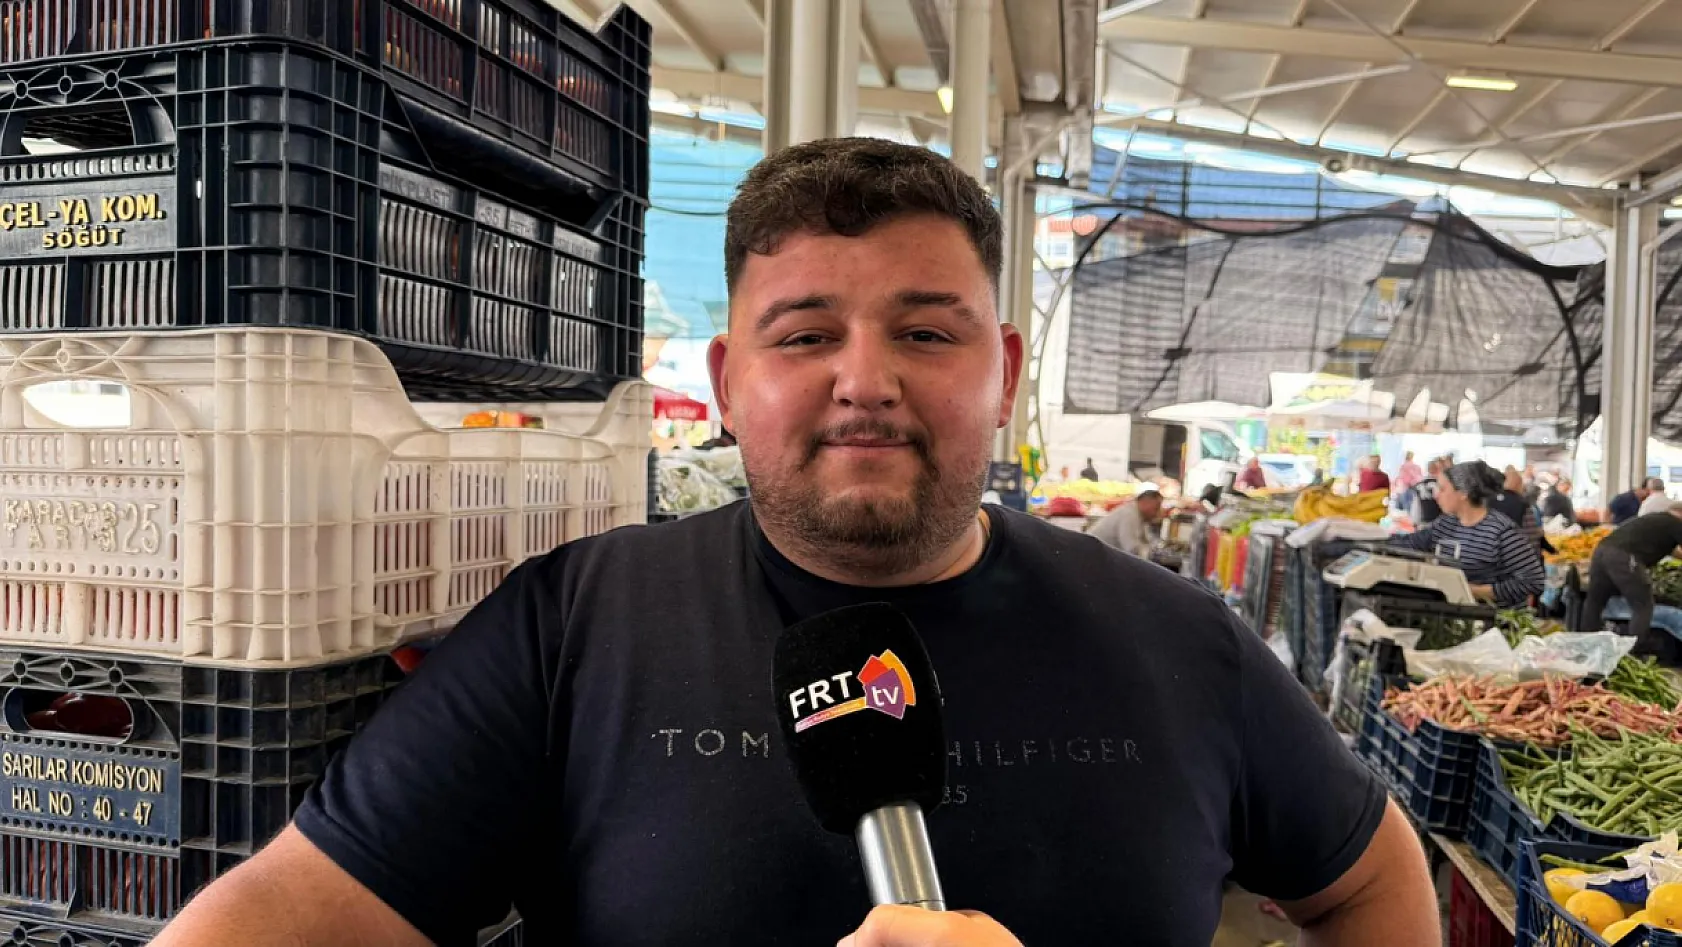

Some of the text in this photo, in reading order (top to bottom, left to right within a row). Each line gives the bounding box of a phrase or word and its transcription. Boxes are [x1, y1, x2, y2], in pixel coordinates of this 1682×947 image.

[102, 194, 164, 221] KOM.
[43, 226, 123, 248] SÖĞÜT
[123, 503, 161, 555] 25
[789, 670, 853, 719] FRT
[871, 686, 899, 707] tv
[659, 728, 1143, 767] TOM HILFIGER
[2, 752, 162, 793] SARILAR KOMİSYON
[12, 785, 42, 812] HAL
[49, 791, 74, 817] NO
[93, 796, 112, 822] 40
[133, 801, 153, 827] 47
